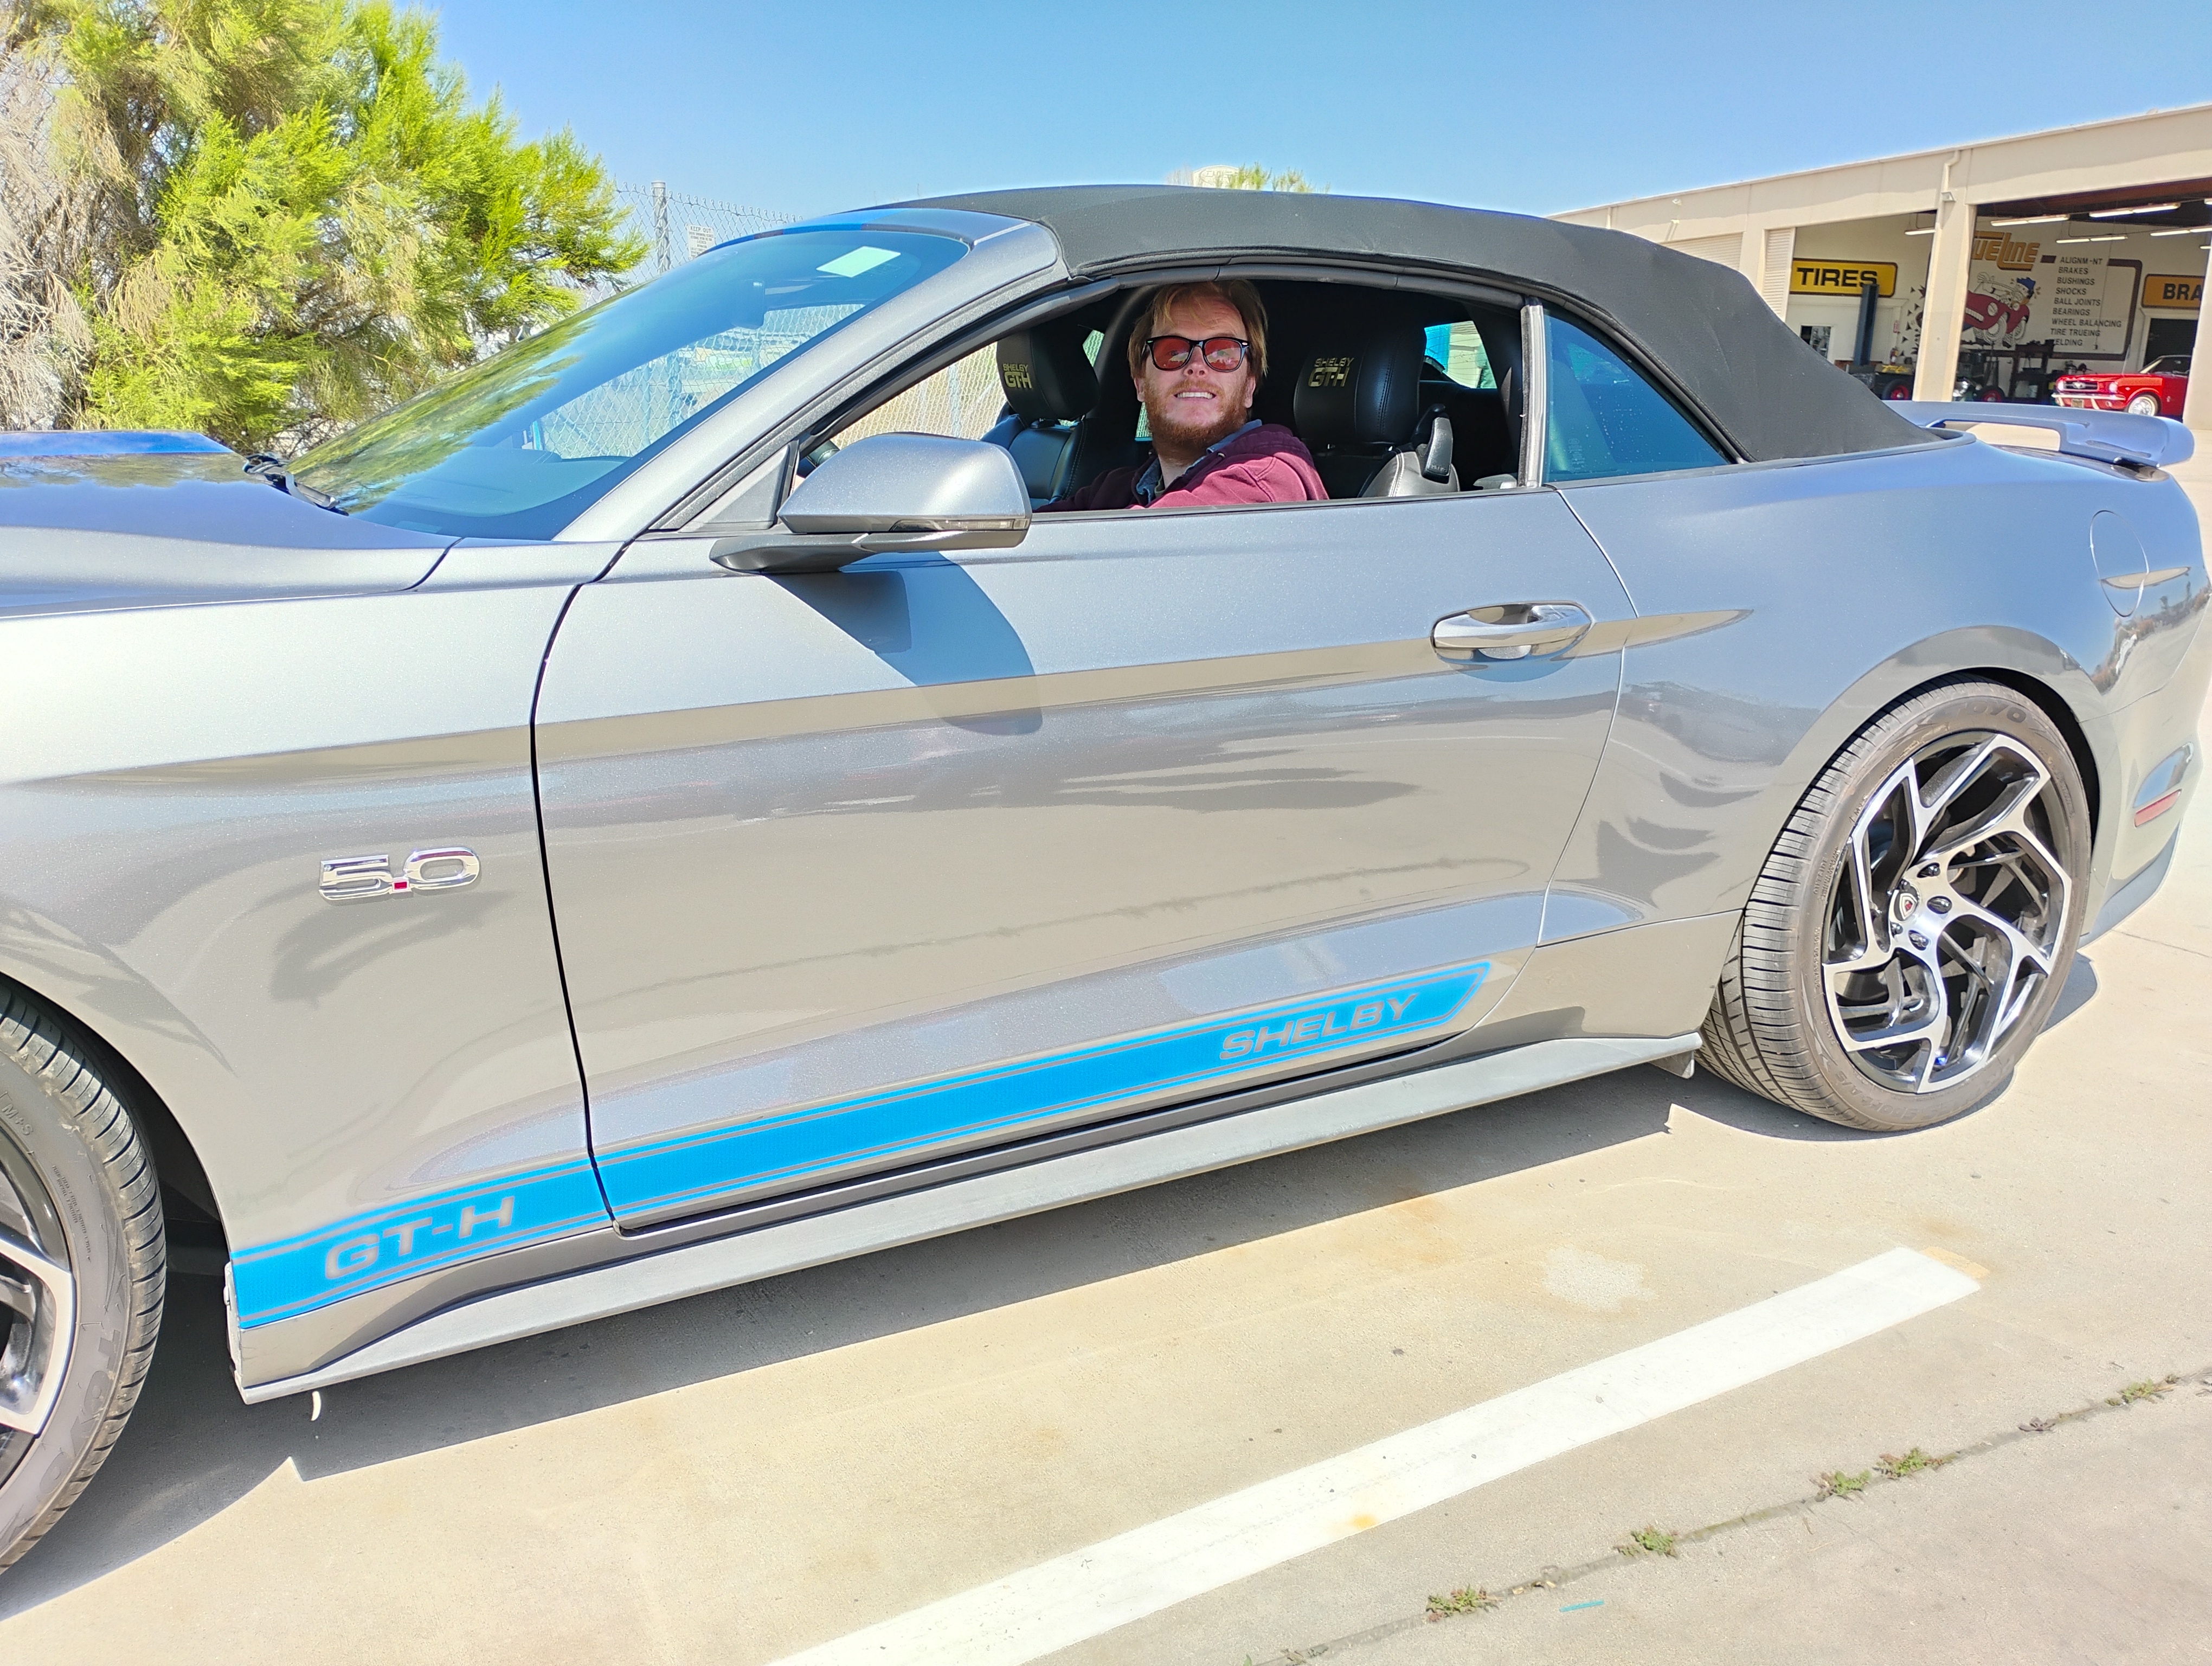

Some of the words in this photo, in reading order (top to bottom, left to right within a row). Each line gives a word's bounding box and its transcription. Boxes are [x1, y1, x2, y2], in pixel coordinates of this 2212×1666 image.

[2059, 266, 2088, 274] BRAKES
[1797, 267, 1877, 287] TIRES
[2056, 277, 2095, 285] BUSHINGS
[2055, 287, 2087, 295] SHOCKS
[2074, 298, 2101, 306] JOINTS
[2053, 307, 2091, 316] BEARINGS
[2079, 319, 2122, 328] BALANCING
[2069, 329, 2101, 337] TRUEING
[1314, 357, 1354, 367] SHELBY
[1002, 363, 1028, 373] SHELBY
[318, 847, 480, 900] 5.0
[1220, 993, 1419, 1060] SHELBY
[2, 1104, 34, 1136] M+S
[325, 1196, 516, 1280] GT-H
